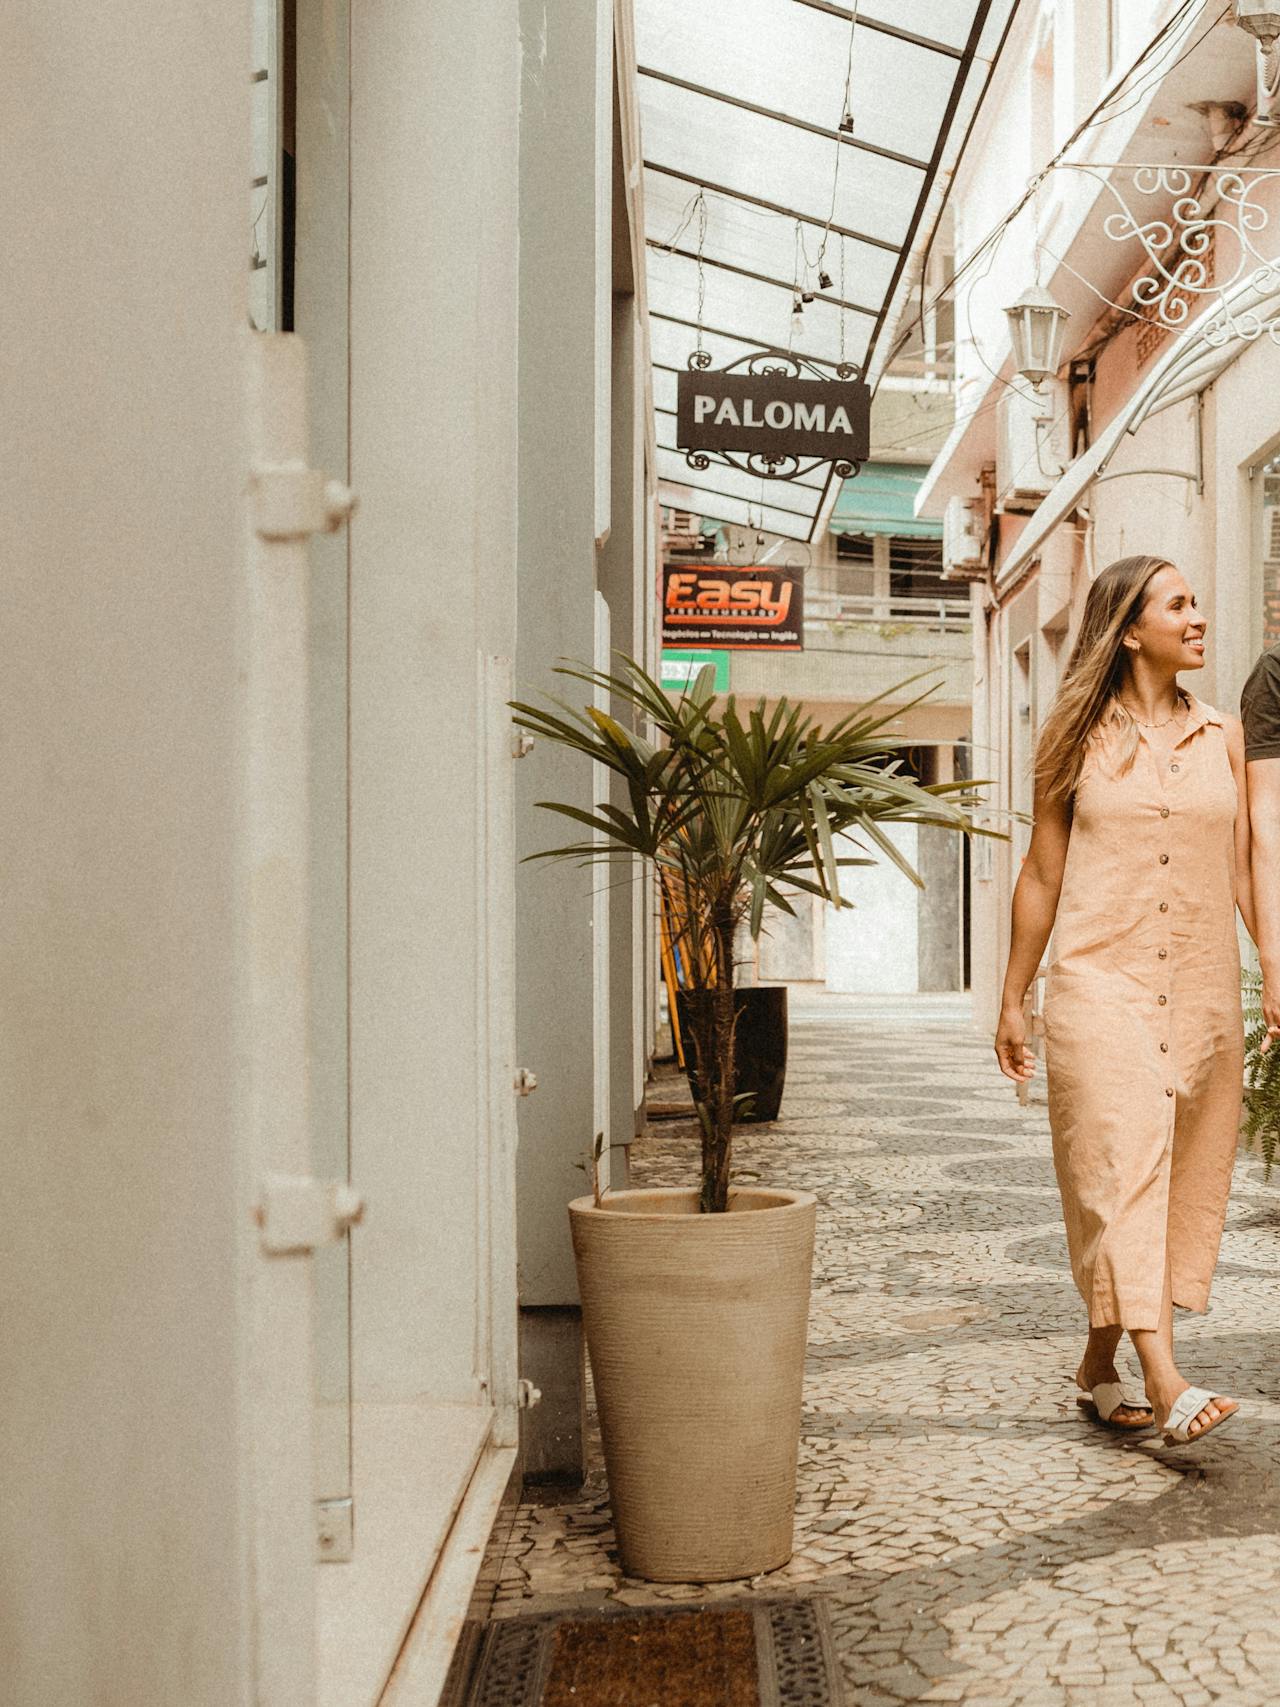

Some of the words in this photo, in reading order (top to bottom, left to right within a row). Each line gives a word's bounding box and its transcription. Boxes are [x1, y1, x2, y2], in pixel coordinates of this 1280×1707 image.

[694, 394, 853, 434] PALOMA
[665, 573, 793, 625] Easy
[669, 607, 775, 617] TREINAMENTOS
[712, 629, 758, 641] Tecnologia
